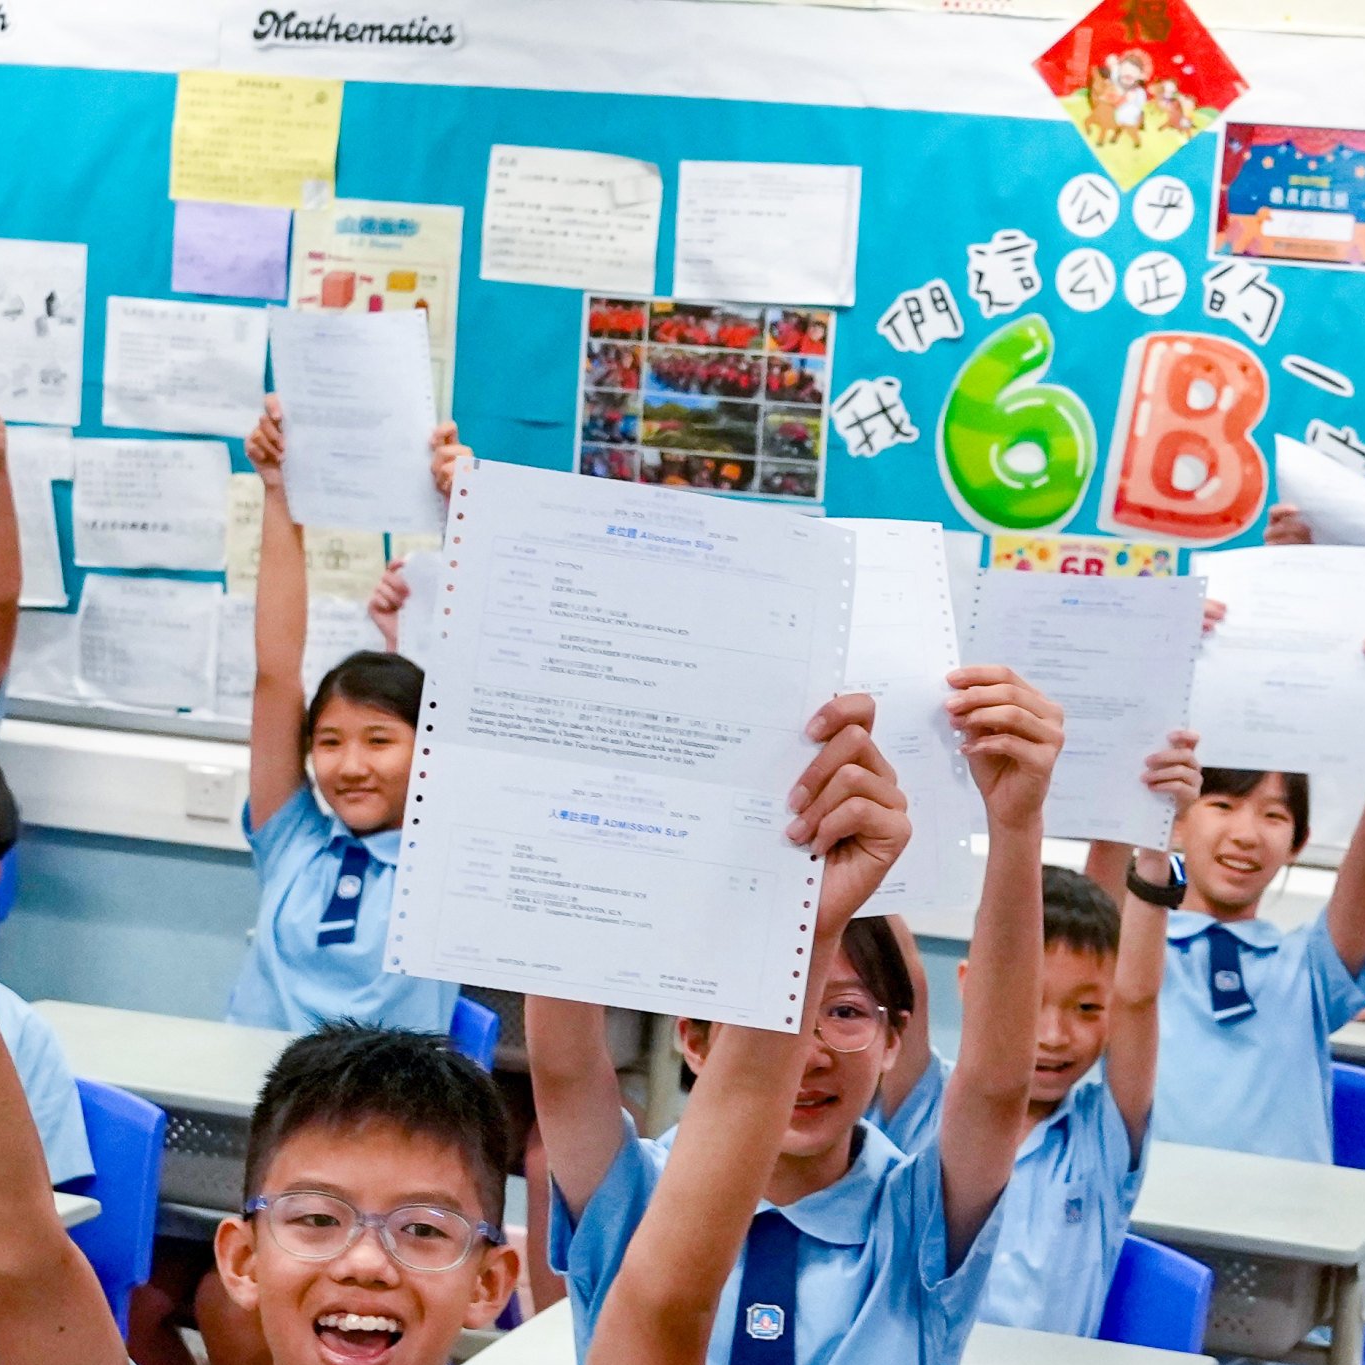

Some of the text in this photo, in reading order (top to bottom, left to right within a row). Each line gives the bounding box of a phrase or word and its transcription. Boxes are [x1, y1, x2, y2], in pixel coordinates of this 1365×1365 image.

[253, 10, 455, 45] Mathematics
[1071, 180, 1184, 231] 公平
[1069, 257, 1180, 306] 公正
[941, 314, 1269, 542] 6B
[603, 818, 662, 835] ADMISSION
[665, 828, 689, 840] SLIP
